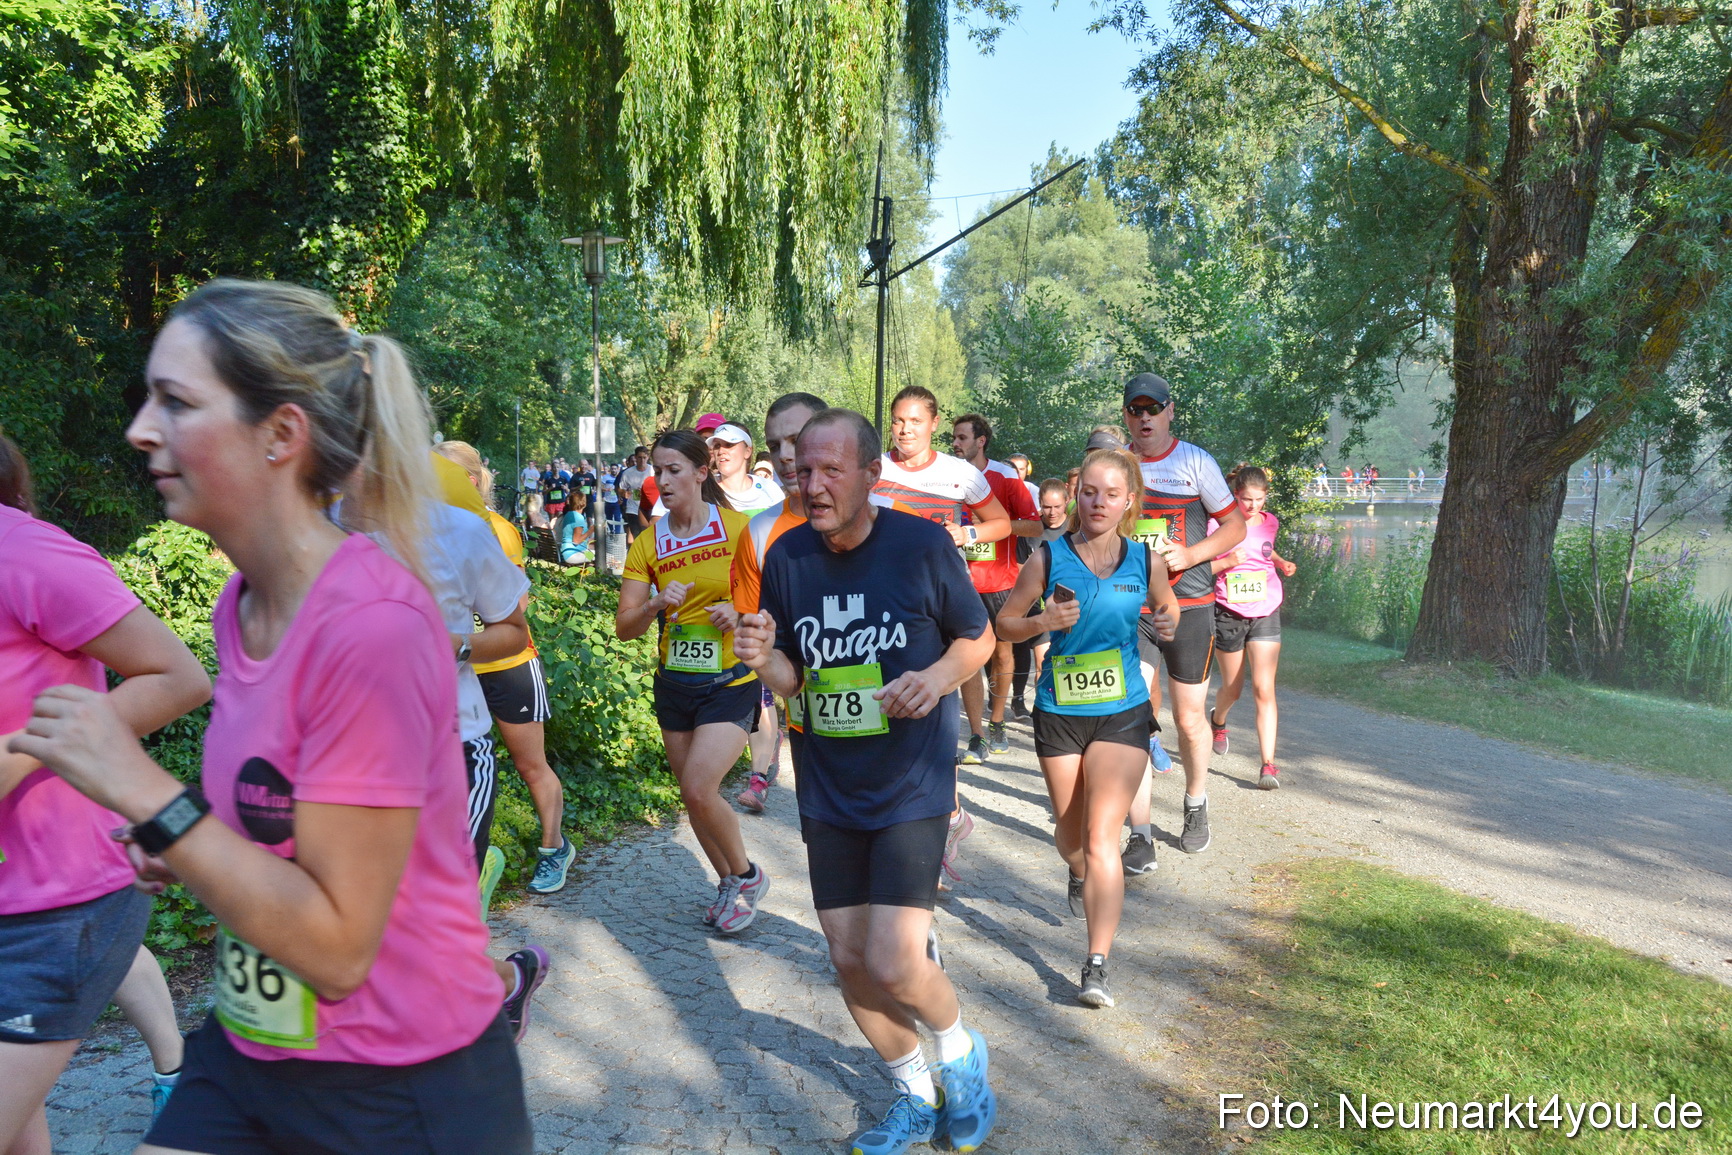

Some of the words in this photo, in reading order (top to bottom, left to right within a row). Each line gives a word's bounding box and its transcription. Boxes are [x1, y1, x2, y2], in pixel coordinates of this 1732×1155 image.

[658, 557, 688, 575] MAX
[691, 547, 732, 565] BÖGL
[1113, 584, 1141, 593] THULE
[1233, 582, 1262, 594] 1443
[671, 640, 714, 659] 1255
[794, 611, 907, 669] Burgis
[1063, 669, 1115, 690] 1946
[815, 692, 863, 717] 278
[821, 718, 836, 726] März
